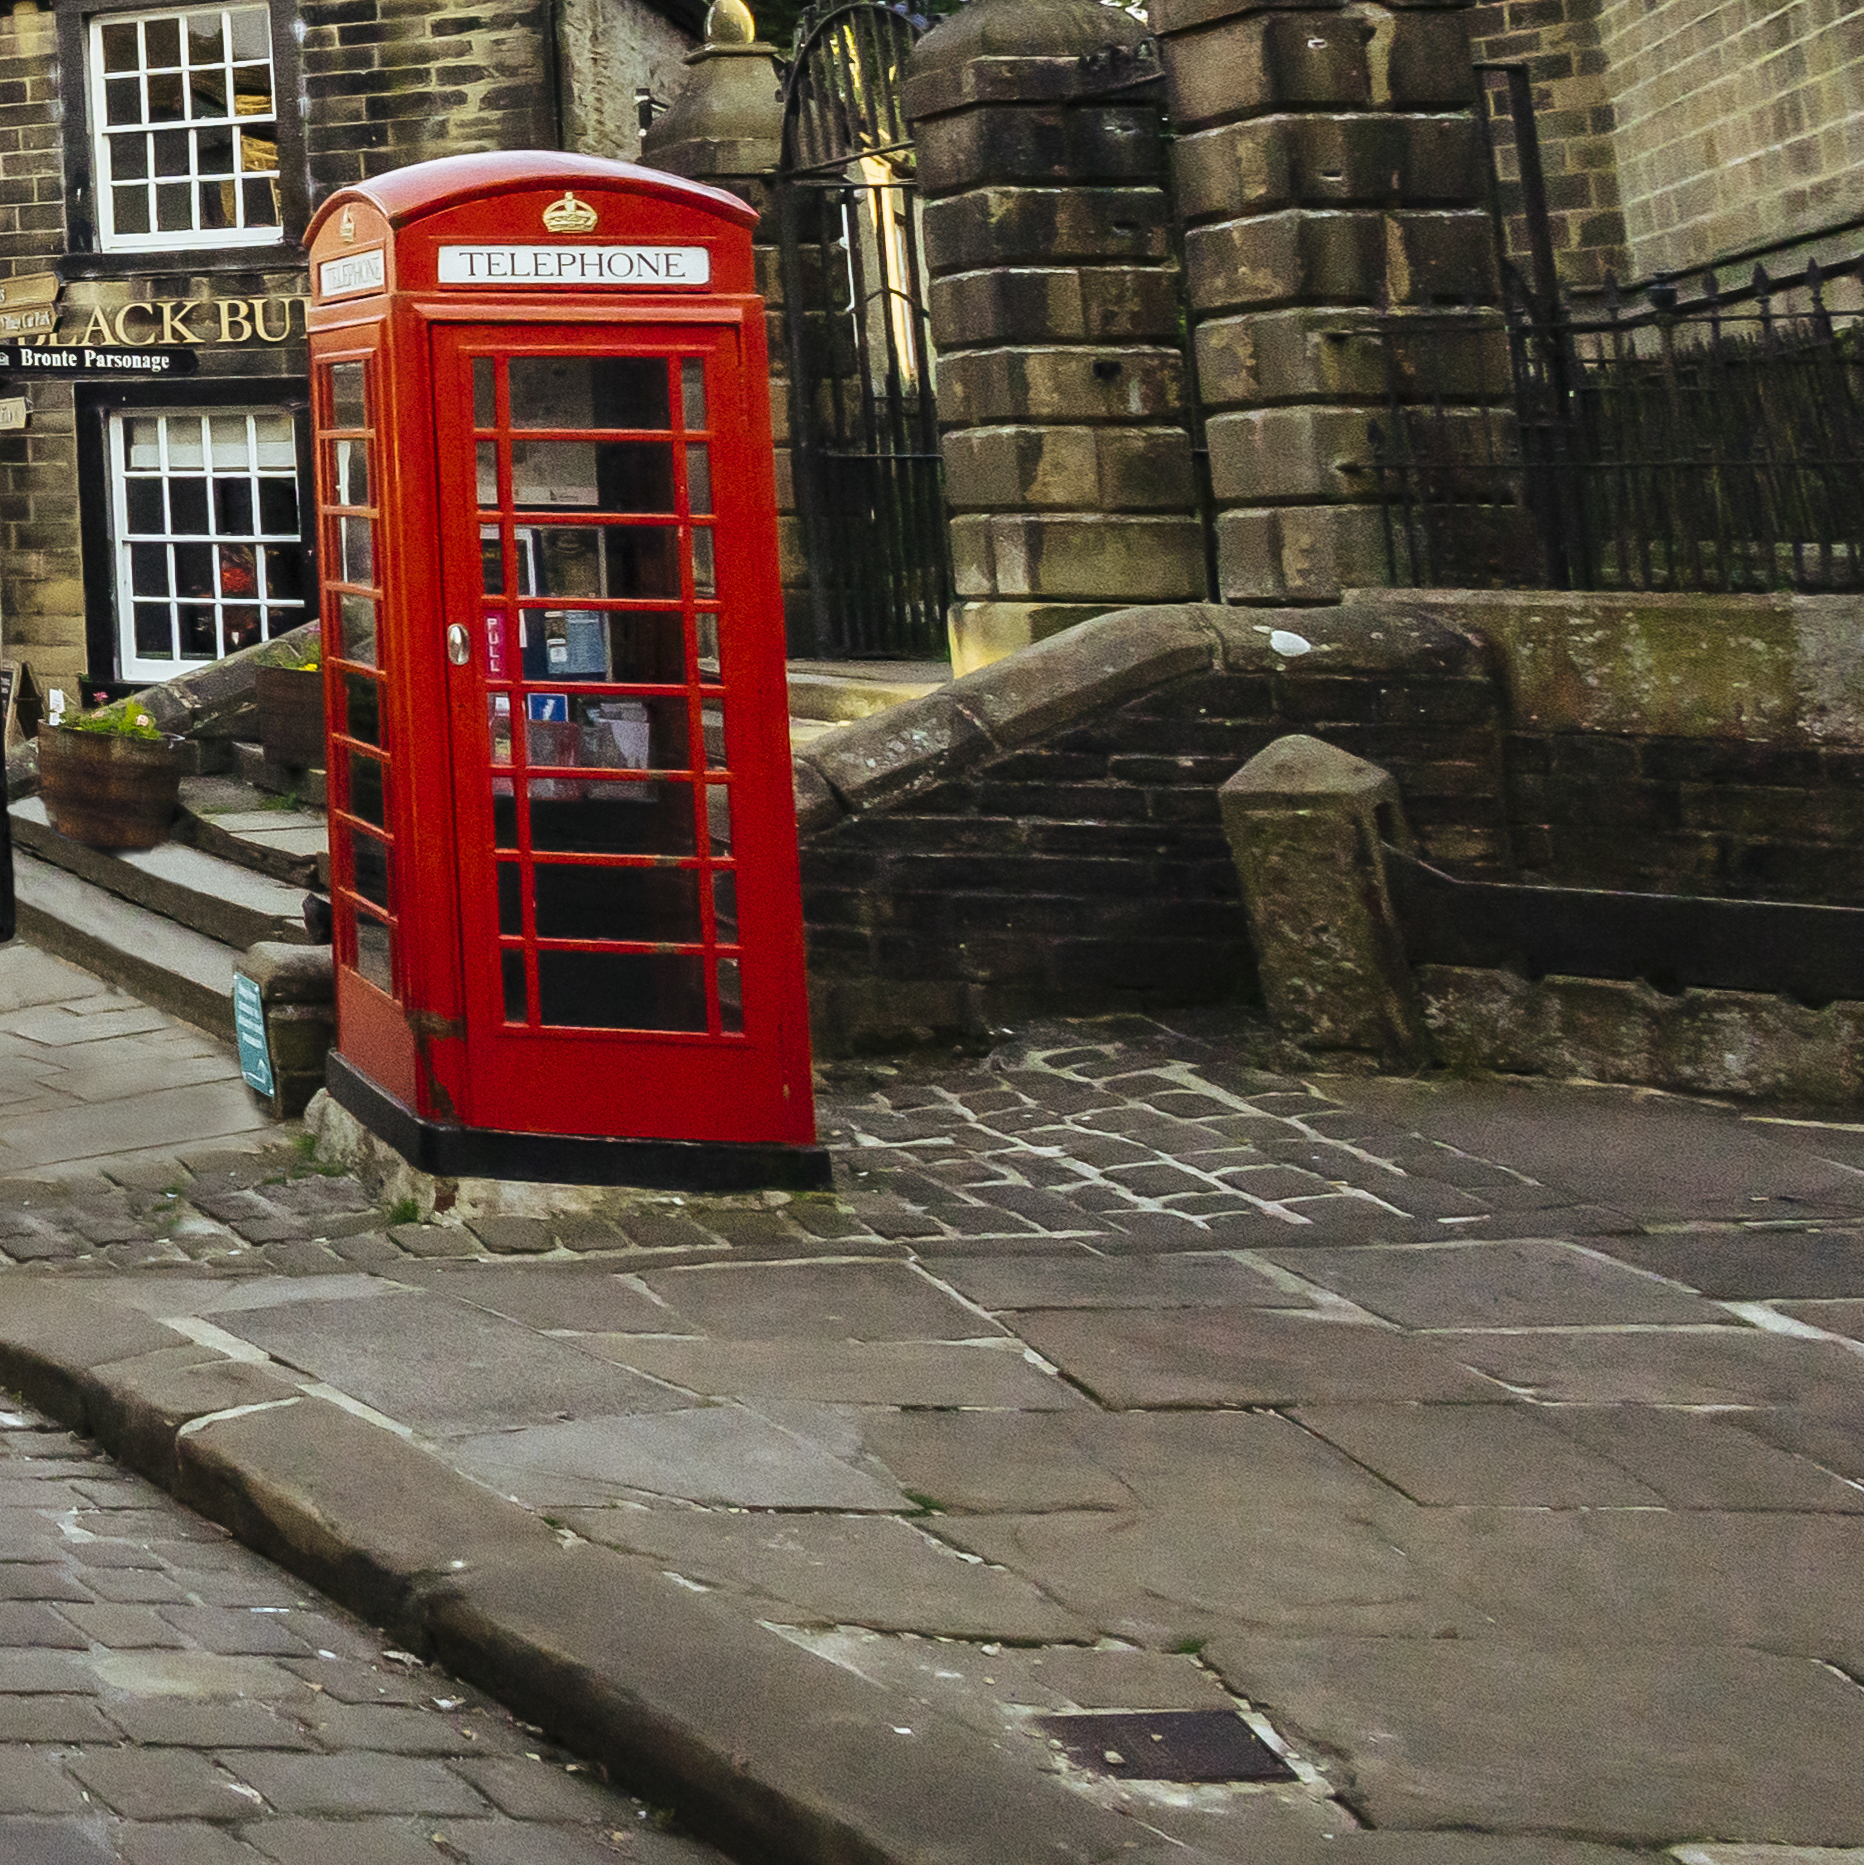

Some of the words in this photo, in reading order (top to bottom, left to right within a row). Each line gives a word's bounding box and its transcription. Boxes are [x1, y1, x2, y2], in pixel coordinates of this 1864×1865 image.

[459, 252, 686, 278] TELEPHONE
[21, 348, 78, 367] Bronte
[84, 350, 170, 372] Parsonage
[486, 617, 501, 673] PULL
